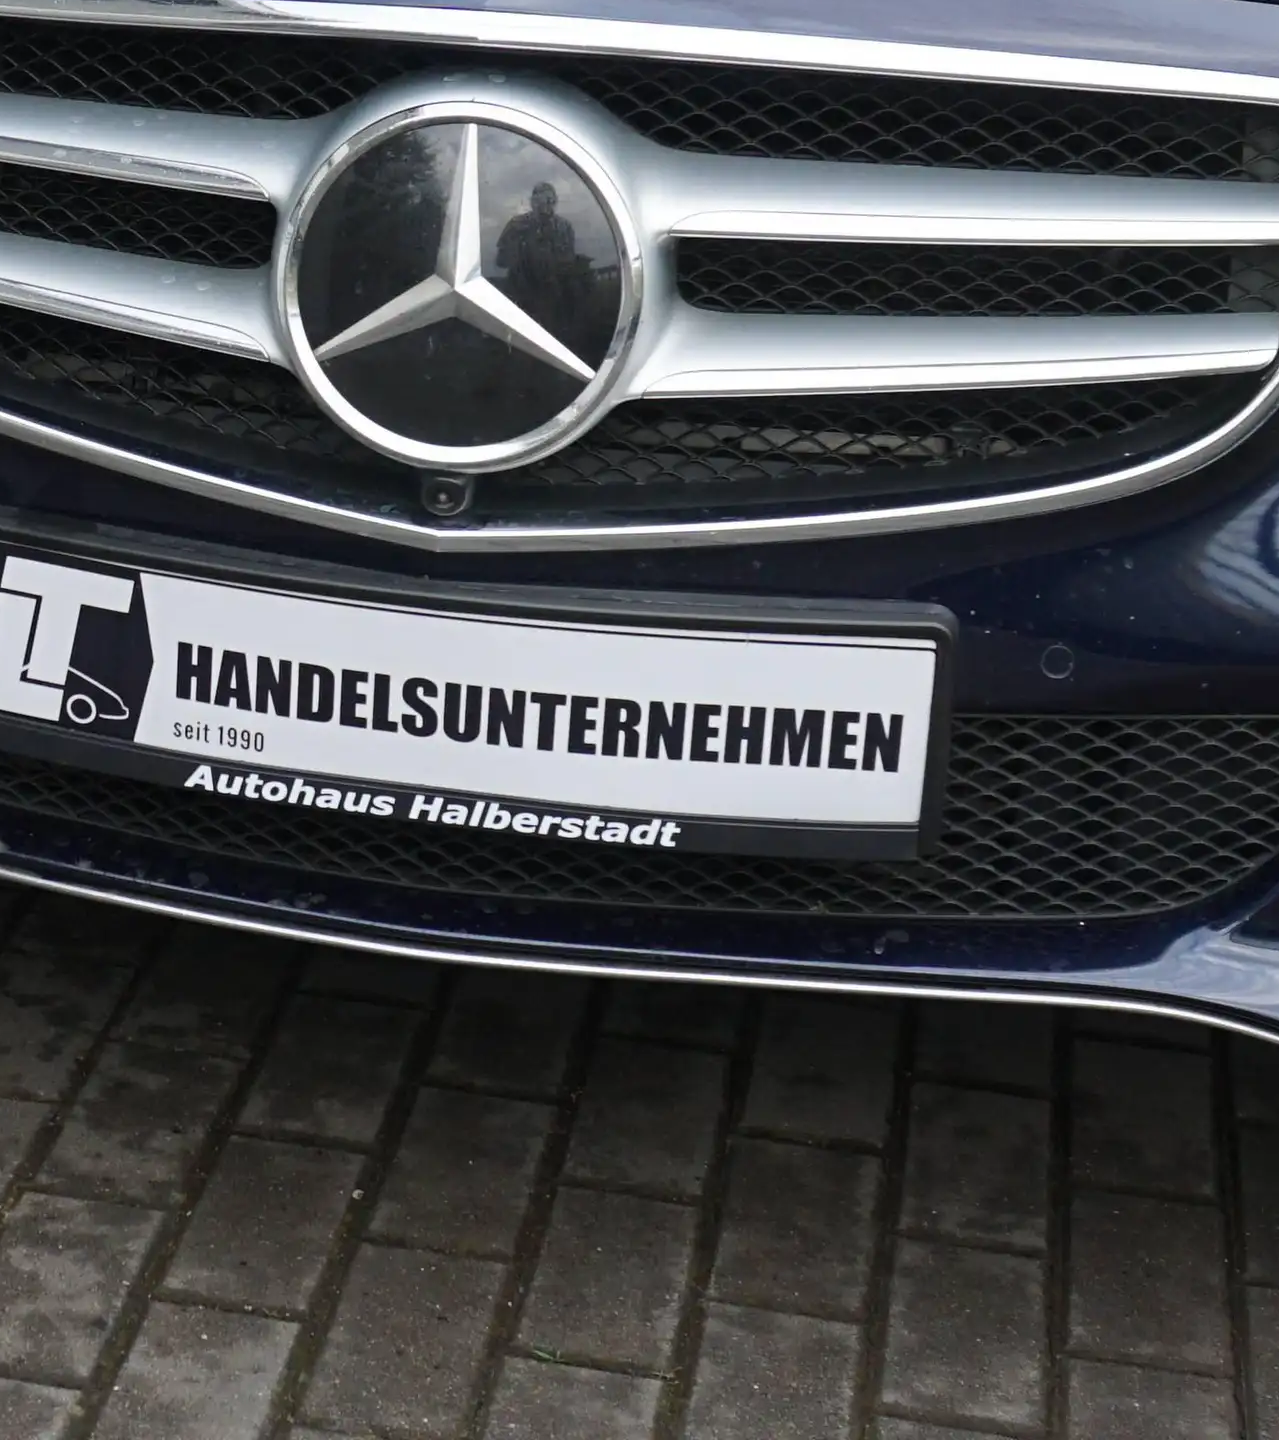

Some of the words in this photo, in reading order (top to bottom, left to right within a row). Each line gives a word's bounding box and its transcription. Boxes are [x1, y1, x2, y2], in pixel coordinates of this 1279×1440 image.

[172, 721, 210, 744] seit
[217, 725, 265, 753] 1990
[175, 641, 905, 773] HANDELSUNTERNEHMEN
[183, 764, 397, 817] Autohaus
[407, 794, 682, 848] Halberstadt
